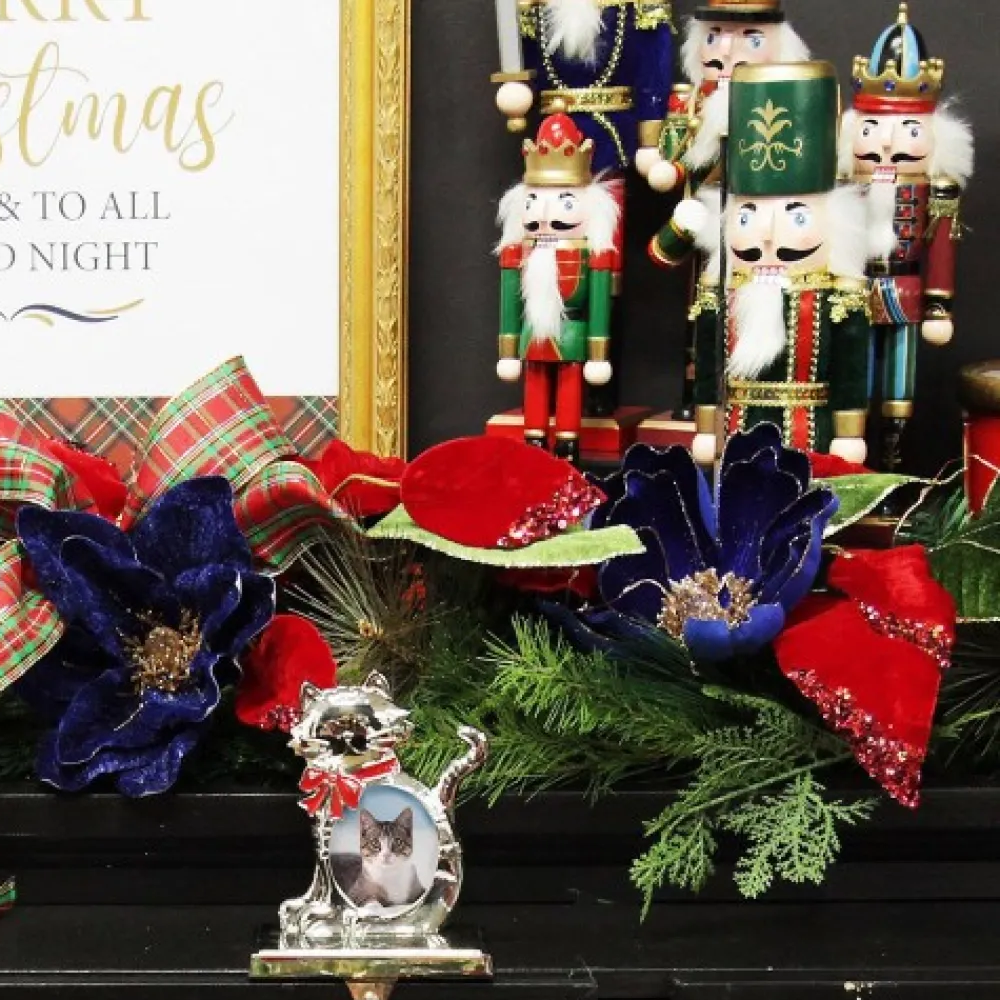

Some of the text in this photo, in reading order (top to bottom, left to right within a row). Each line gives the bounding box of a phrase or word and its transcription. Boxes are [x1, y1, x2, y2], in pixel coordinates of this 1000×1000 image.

[33, 191, 86, 221] TO
[101, 190, 170, 219] ALL
[29, 241, 158, 271] NIGHT
